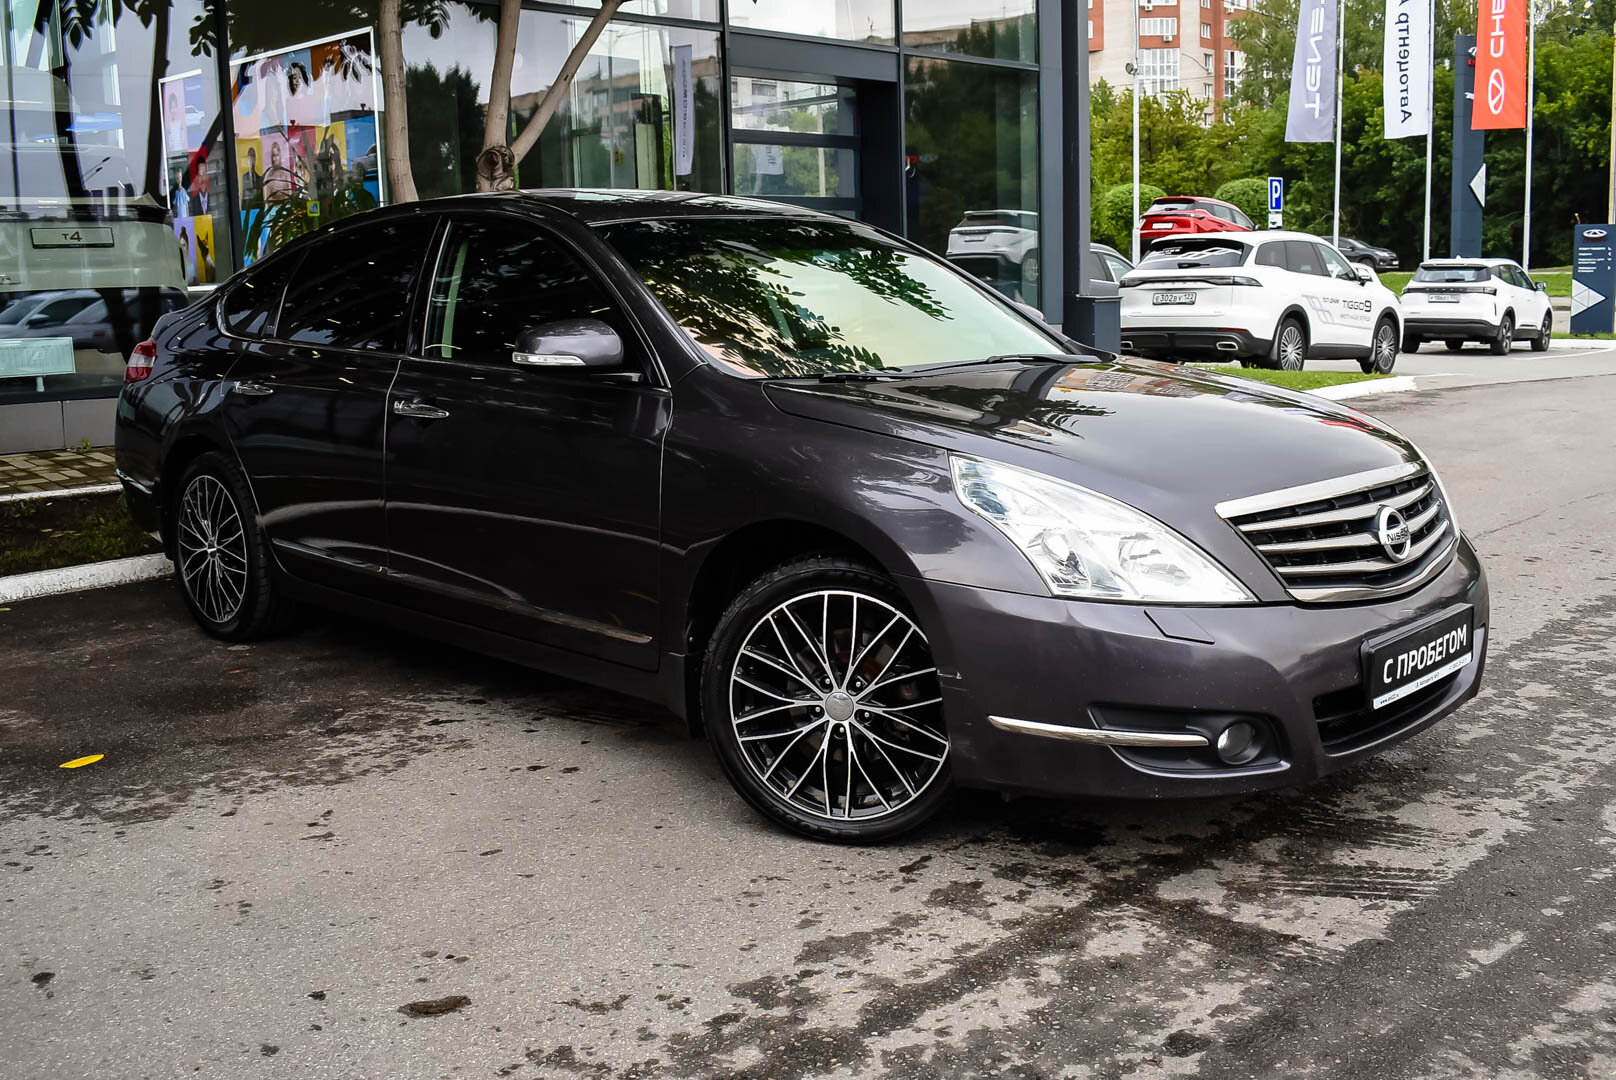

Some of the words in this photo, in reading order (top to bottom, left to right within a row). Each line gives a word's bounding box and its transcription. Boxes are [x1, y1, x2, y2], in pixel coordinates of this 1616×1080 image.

[1272, 181, 1280, 207] P
[1383, 658, 1394, 684] С
[1396, 623, 1467, 679] ПРОБЕГОМ
